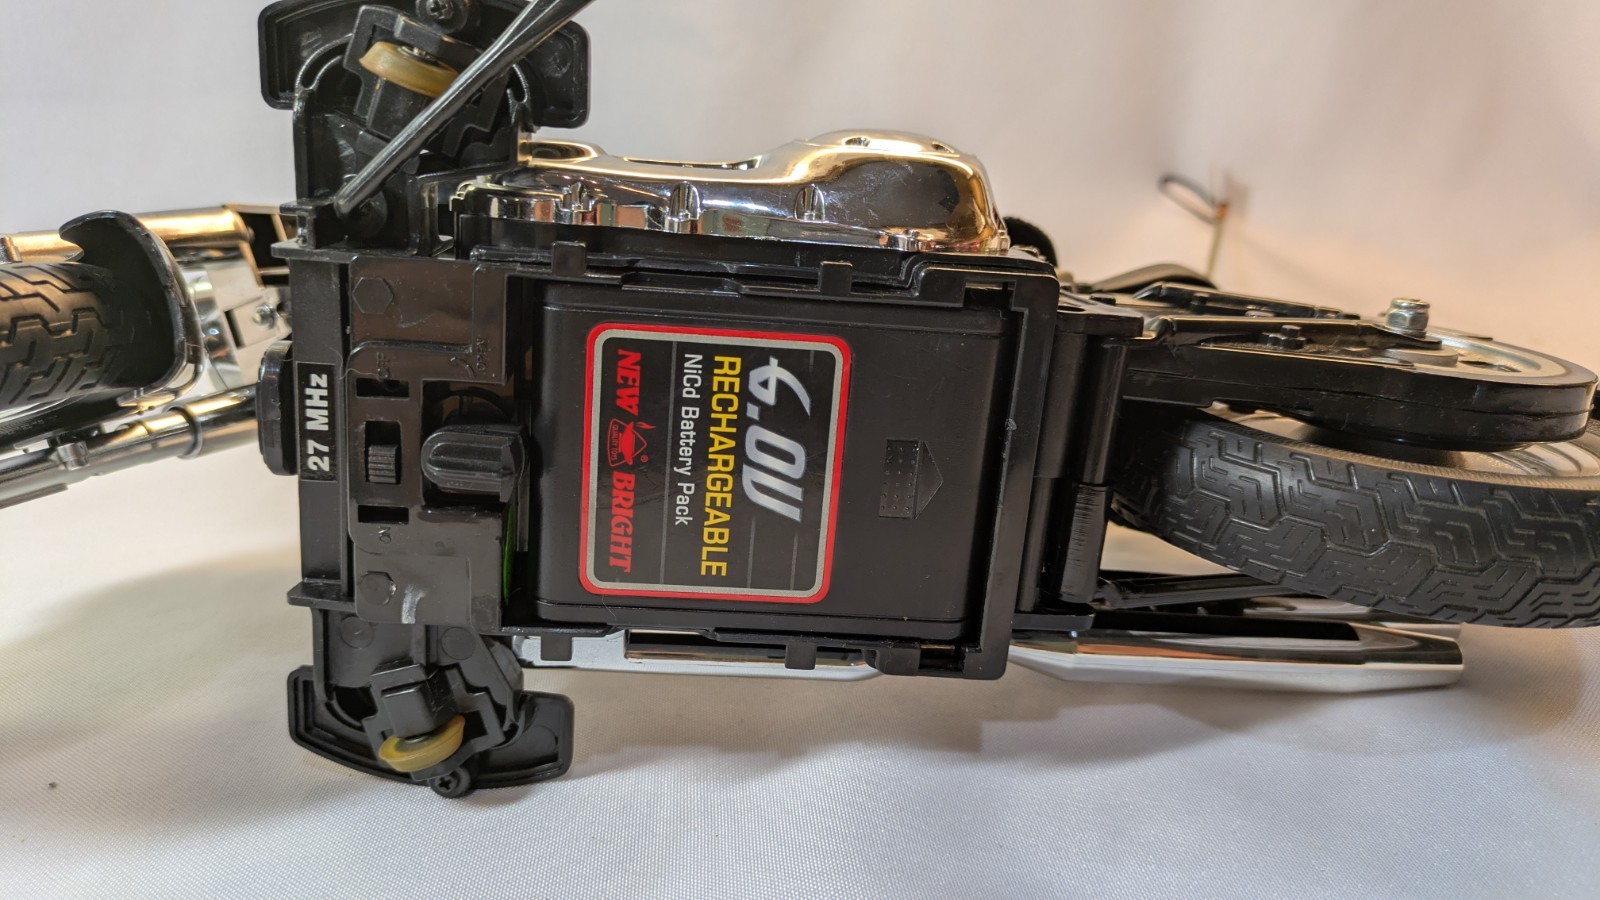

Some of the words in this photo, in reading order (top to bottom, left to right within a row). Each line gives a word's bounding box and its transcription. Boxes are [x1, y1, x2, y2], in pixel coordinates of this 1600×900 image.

[305, 373, 329, 431] MHz
[616, 349, 641, 416] NEW
[682, 353, 703, 398] NiCd
[307, 440, 330, 472] 27
[611, 424, 619, 446] QUALITY
[674, 406, 700, 476] Battery
[742, 355, 811, 522] 6.0V
[701, 355, 742, 577] RECHARGEABLE
[609, 471, 636, 573] BRIGHT
[674, 482, 695, 526] Pack
[379, 526, 391, 544] ON
